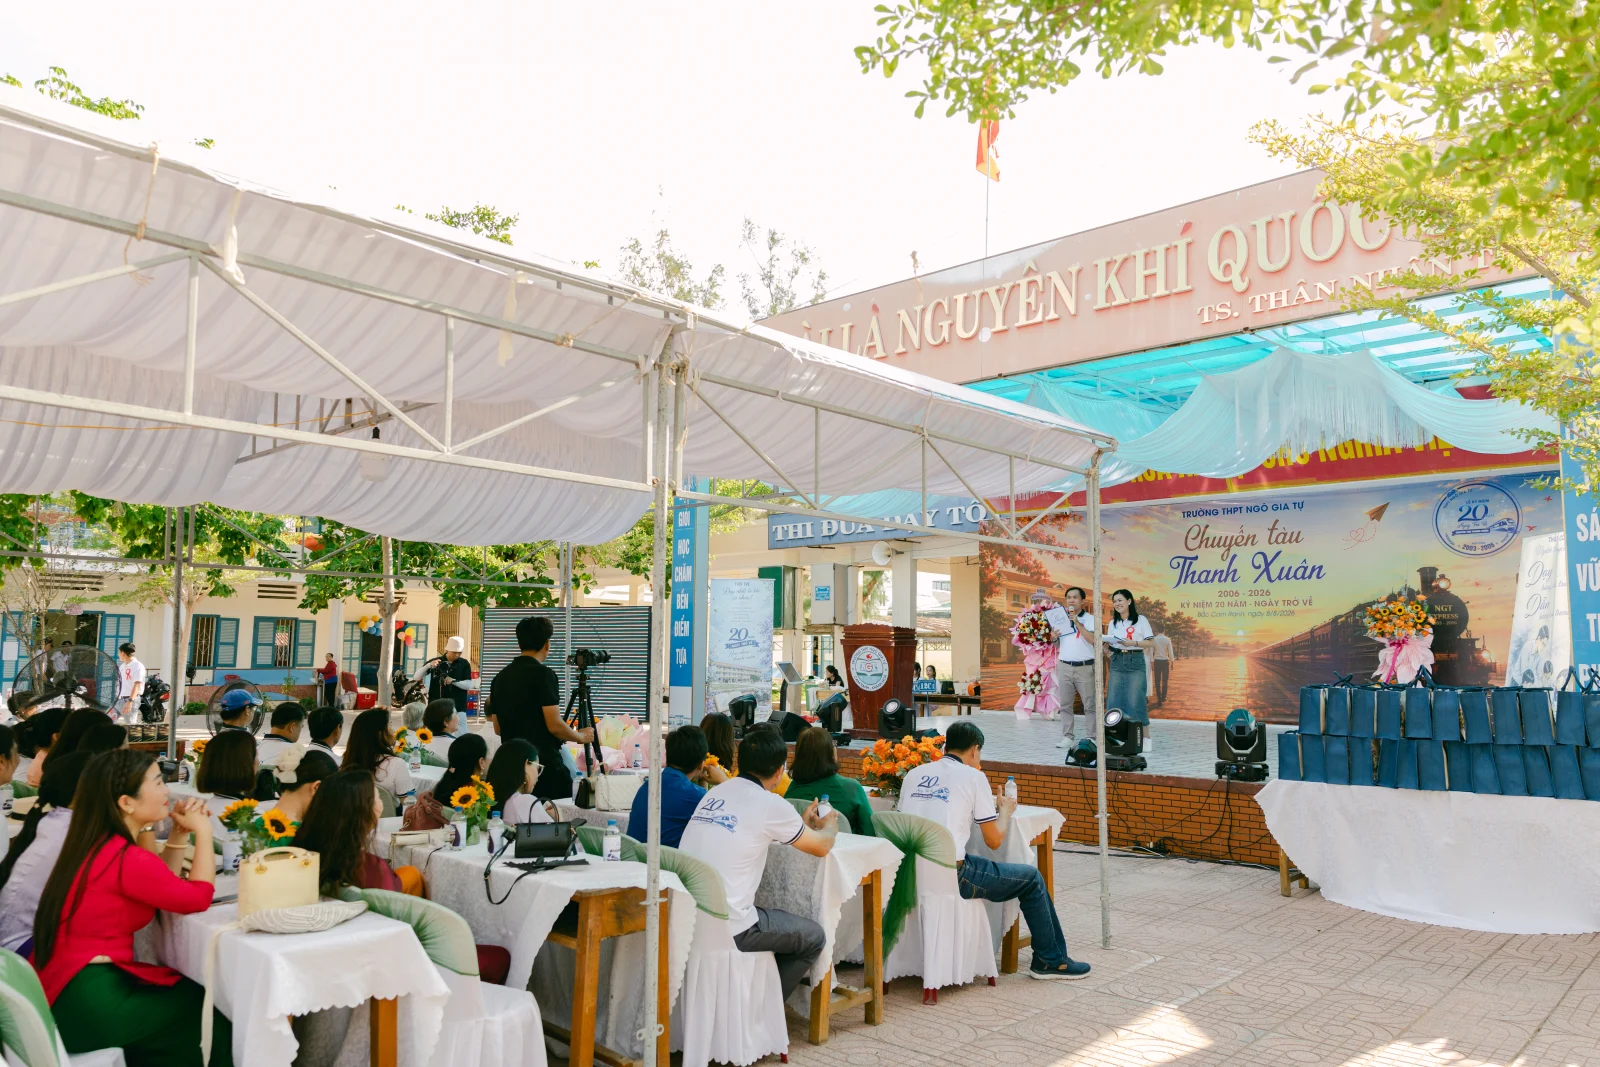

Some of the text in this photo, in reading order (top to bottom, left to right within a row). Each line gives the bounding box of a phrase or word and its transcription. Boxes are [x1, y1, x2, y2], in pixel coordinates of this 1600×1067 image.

[894, 260, 1083, 355] NGUYÊN
[1093, 221, 1194, 311] KHÍ
[1197, 301, 1240, 324] TS.
[1249, 279, 1338, 314] THÂN
[1181, 501, 1305, 519] TRƯỜNG THPT NGÔ GIA TỰ
[1457, 503, 1489, 523] 20
[772, 521, 814, 541] THI
[1184, 518, 1304, 562] Chuyến tàu
[677, 538, 690, 558] HỌC
[674, 564, 692, 583] CHĂM
[1169, 550, 1327, 589] Thanh Xuân
[676, 589, 689, 609] BẾN
[1217, 589, 1240, 598] 2006
[1248, 588, 1271, 597] 2026
[1193, 600, 1213, 611] NIỆM
[1254, 598, 1280, 608] NGÀY
[1281, 596, 1300, 607] TRỞ
[1302, 595, 1313, 606] VỀ
[1434, 604, 1453, 612] NGT
[728, 627, 749, 642] 20
[917, 775, 939, 788] 20
[700, 797, 725, 811] 20
